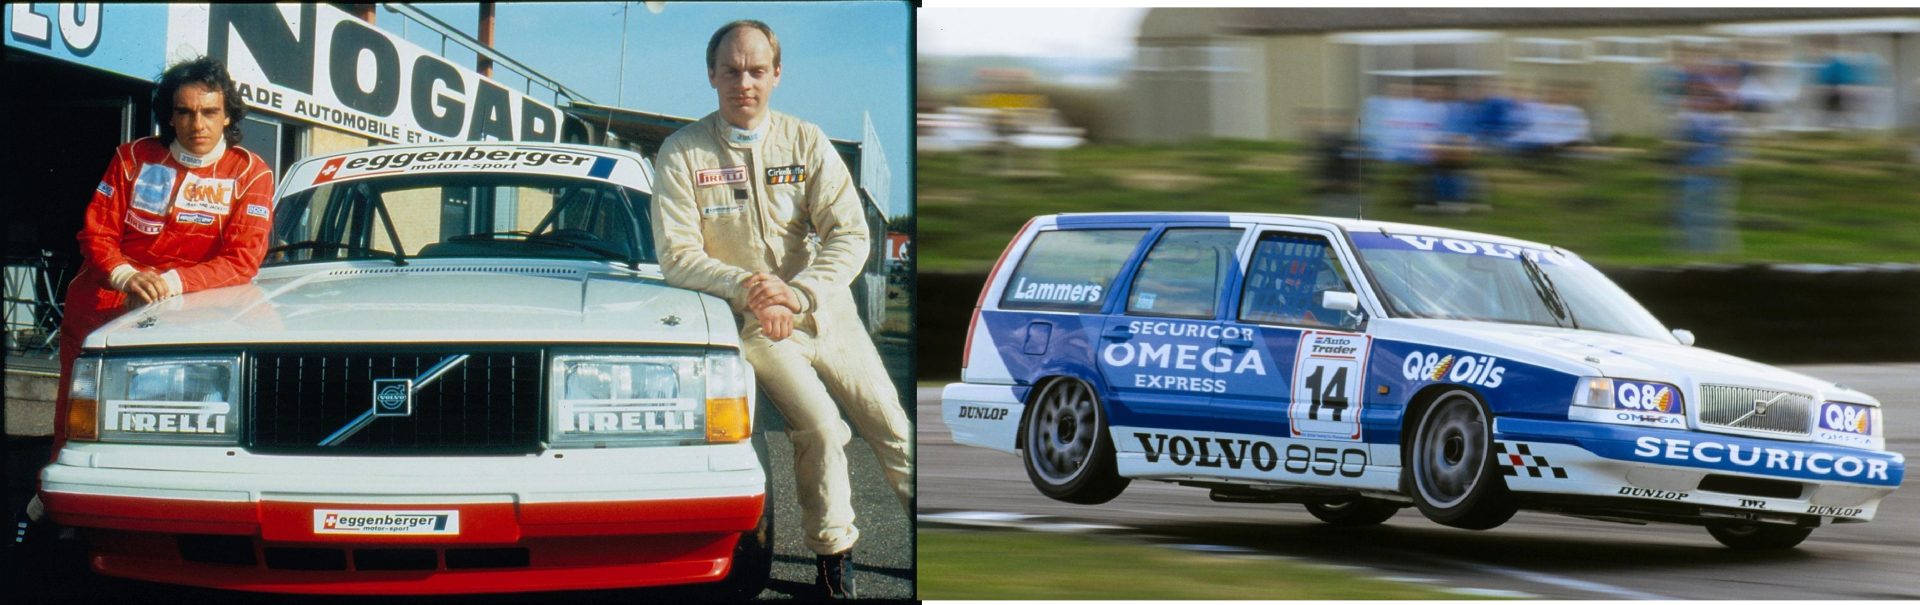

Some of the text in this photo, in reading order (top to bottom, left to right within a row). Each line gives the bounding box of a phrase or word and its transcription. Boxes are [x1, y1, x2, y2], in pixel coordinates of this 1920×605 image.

[230, 79, 422, 143] ADE AUTOMOBILE ET
[346, 147, 590, 171] eggenberger
[411, 161, 517, 171] motor-sport
[699, 169, 744, 183] PIRELLI
[1014, 277, 1101, 303] Lammers
[1129, 321, 1254, 341] SECURICOR
[1322, 337, 1350, 346] Auto
[1103, 342, 1266, 375] OMEGA
[1312, 345, 1357, 355] Trader
[1403, 351, 1506, 388] Q8 Oils
[1135, 374, 1226, 393] EXPRESS
[1305, 365, 1348, 421] 14
[1618, 382, 1656, 410] Q8
[105, 399, 231, 433] PIRELLI
[558, 398, 697, 432] PIRELLI
[958, 405, 1008, 420] DUNLOP
[1617, 413, 1680, 424] OMEGA
[1825, 404, 1856, 432] Q8
[1133, 431, 1367, 477] VOLVO 850
[1634, 436, 1889, 480] SECURICOR
[1618, 486, 1689, 500] DUNLOP
[339, 515, 434, 527] eggenberger
[1806, 505, 1863, 516] DUNLOP
